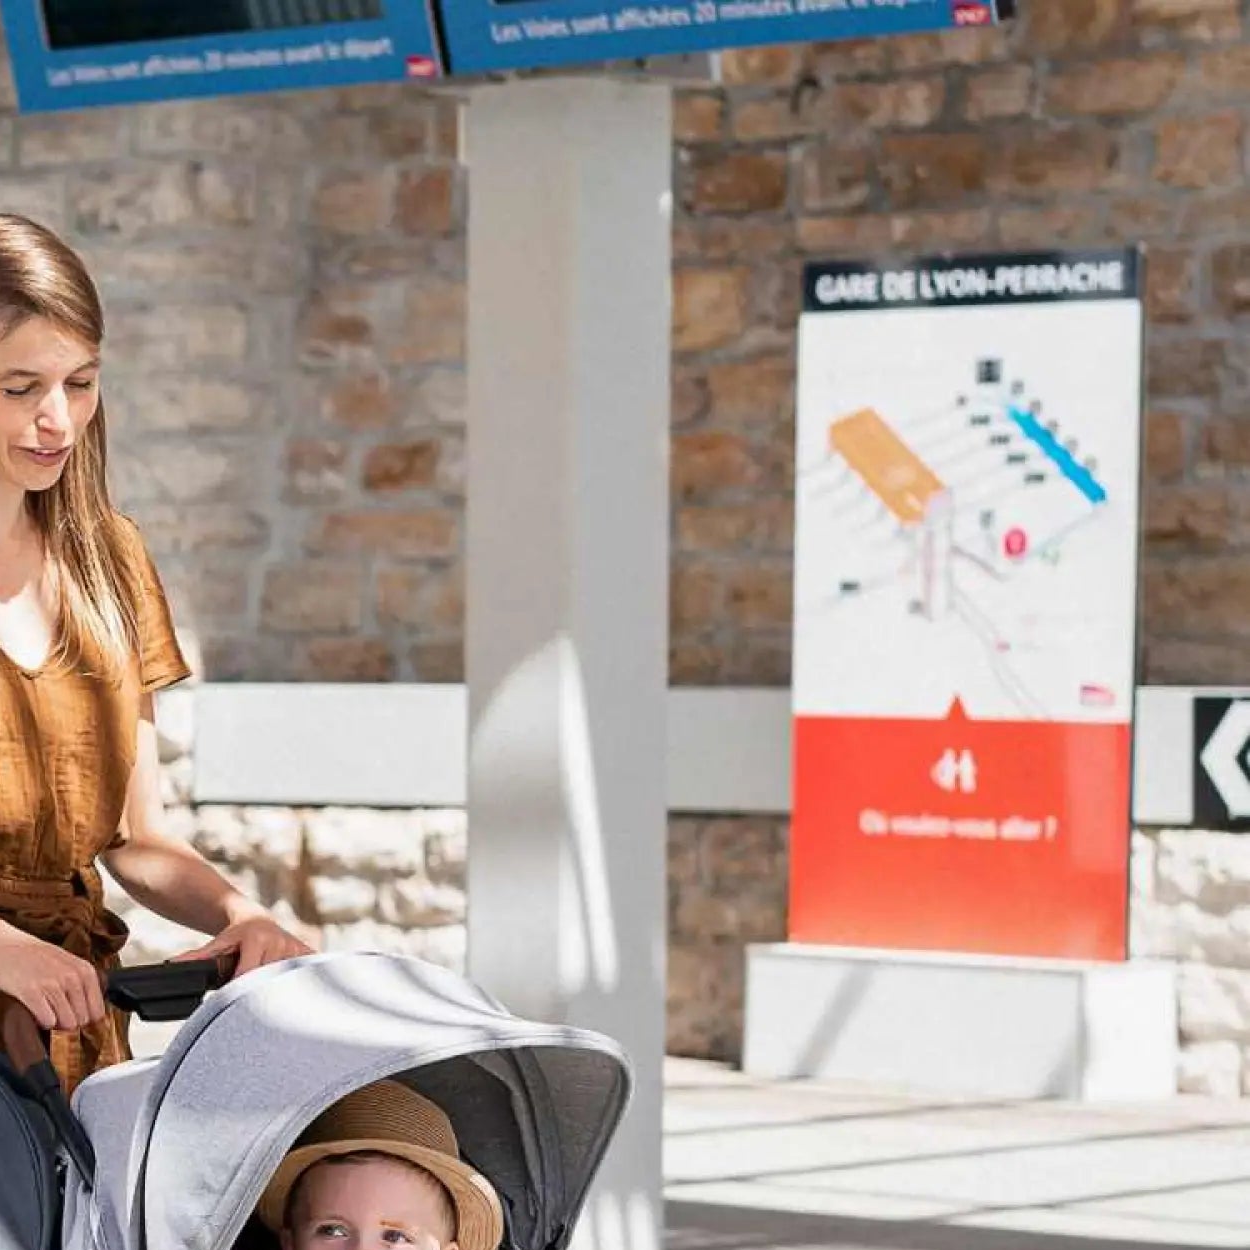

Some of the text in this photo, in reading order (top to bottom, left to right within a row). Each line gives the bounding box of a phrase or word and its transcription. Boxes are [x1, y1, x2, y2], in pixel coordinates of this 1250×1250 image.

[815, 260, 1123, 303] GARE DE LYON-PERRACHE
